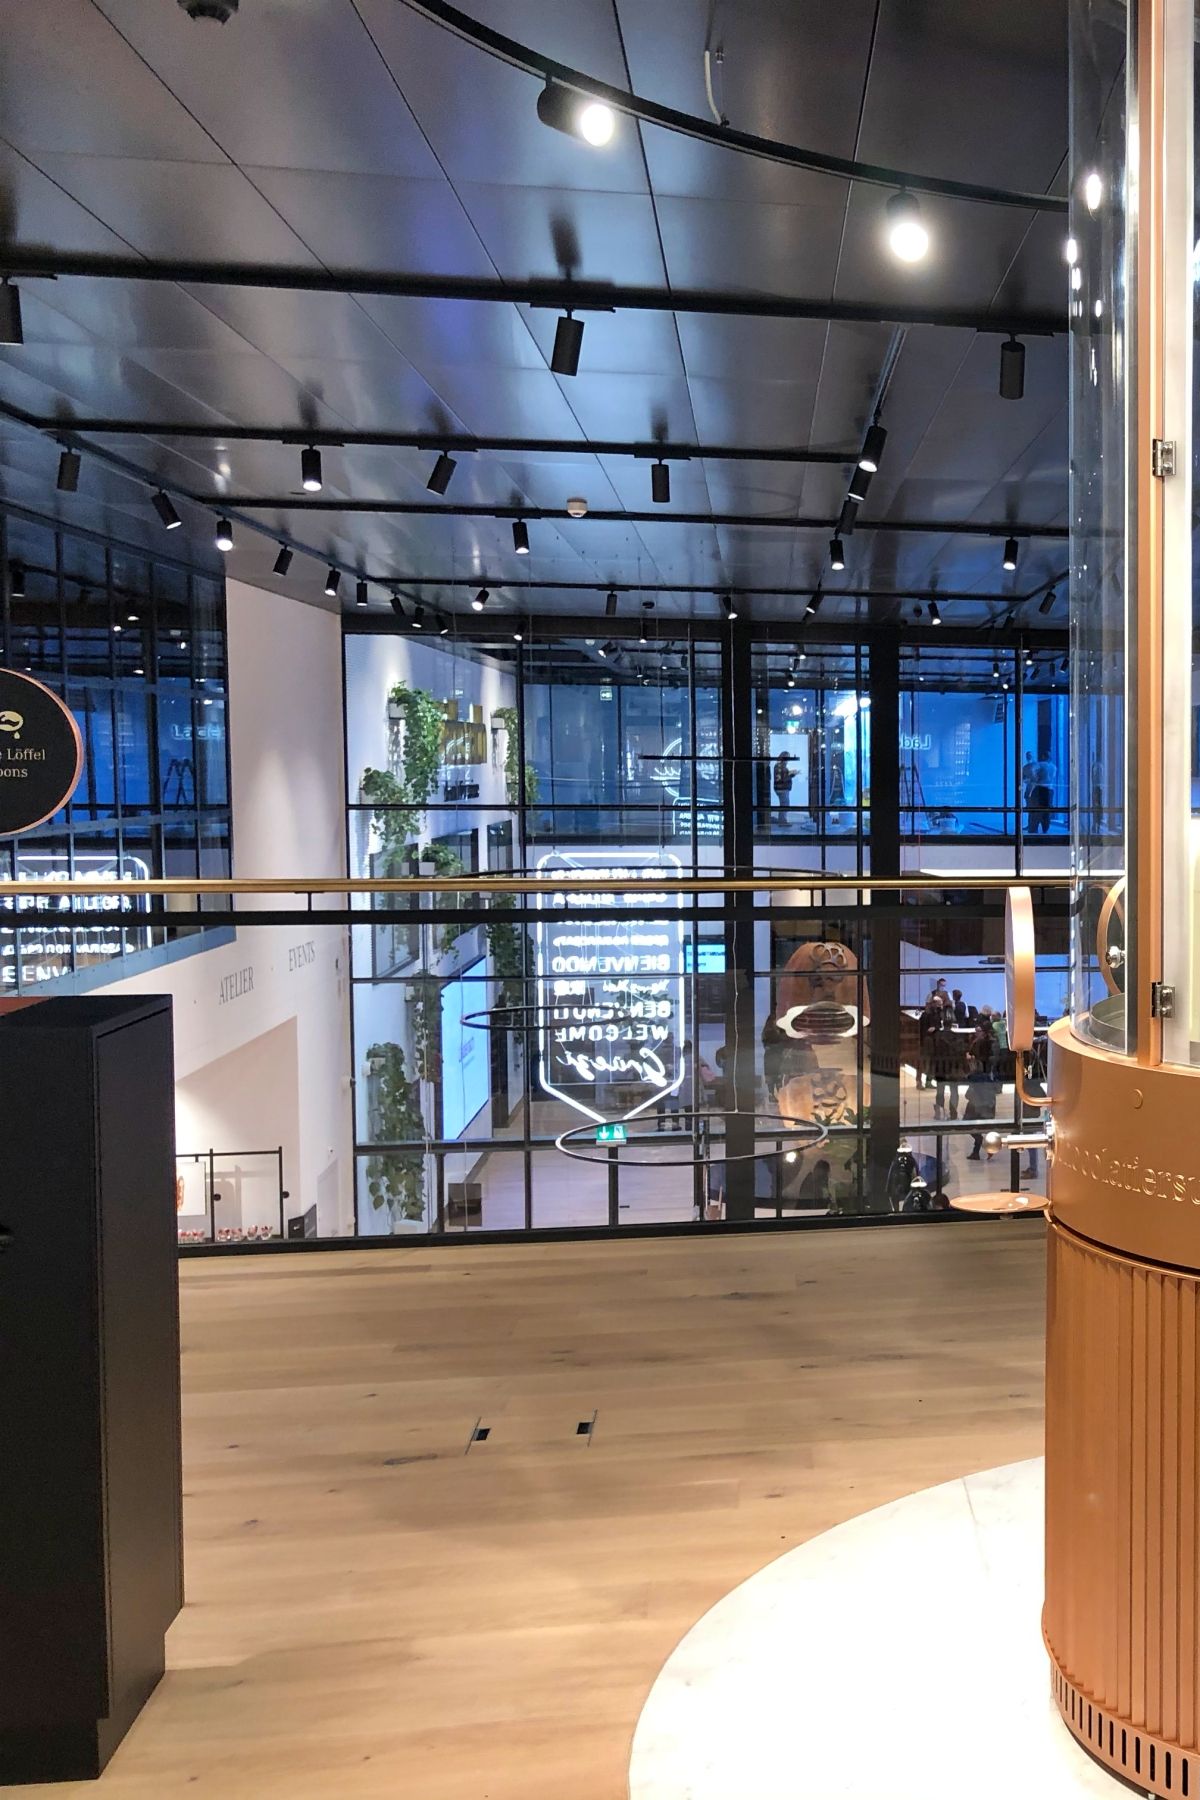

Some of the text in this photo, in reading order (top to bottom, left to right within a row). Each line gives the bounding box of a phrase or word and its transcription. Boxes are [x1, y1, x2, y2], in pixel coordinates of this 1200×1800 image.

[7, 748, 46, 760] Löffel
[219, 941, 316, 1006] ATELIER EVENTS
